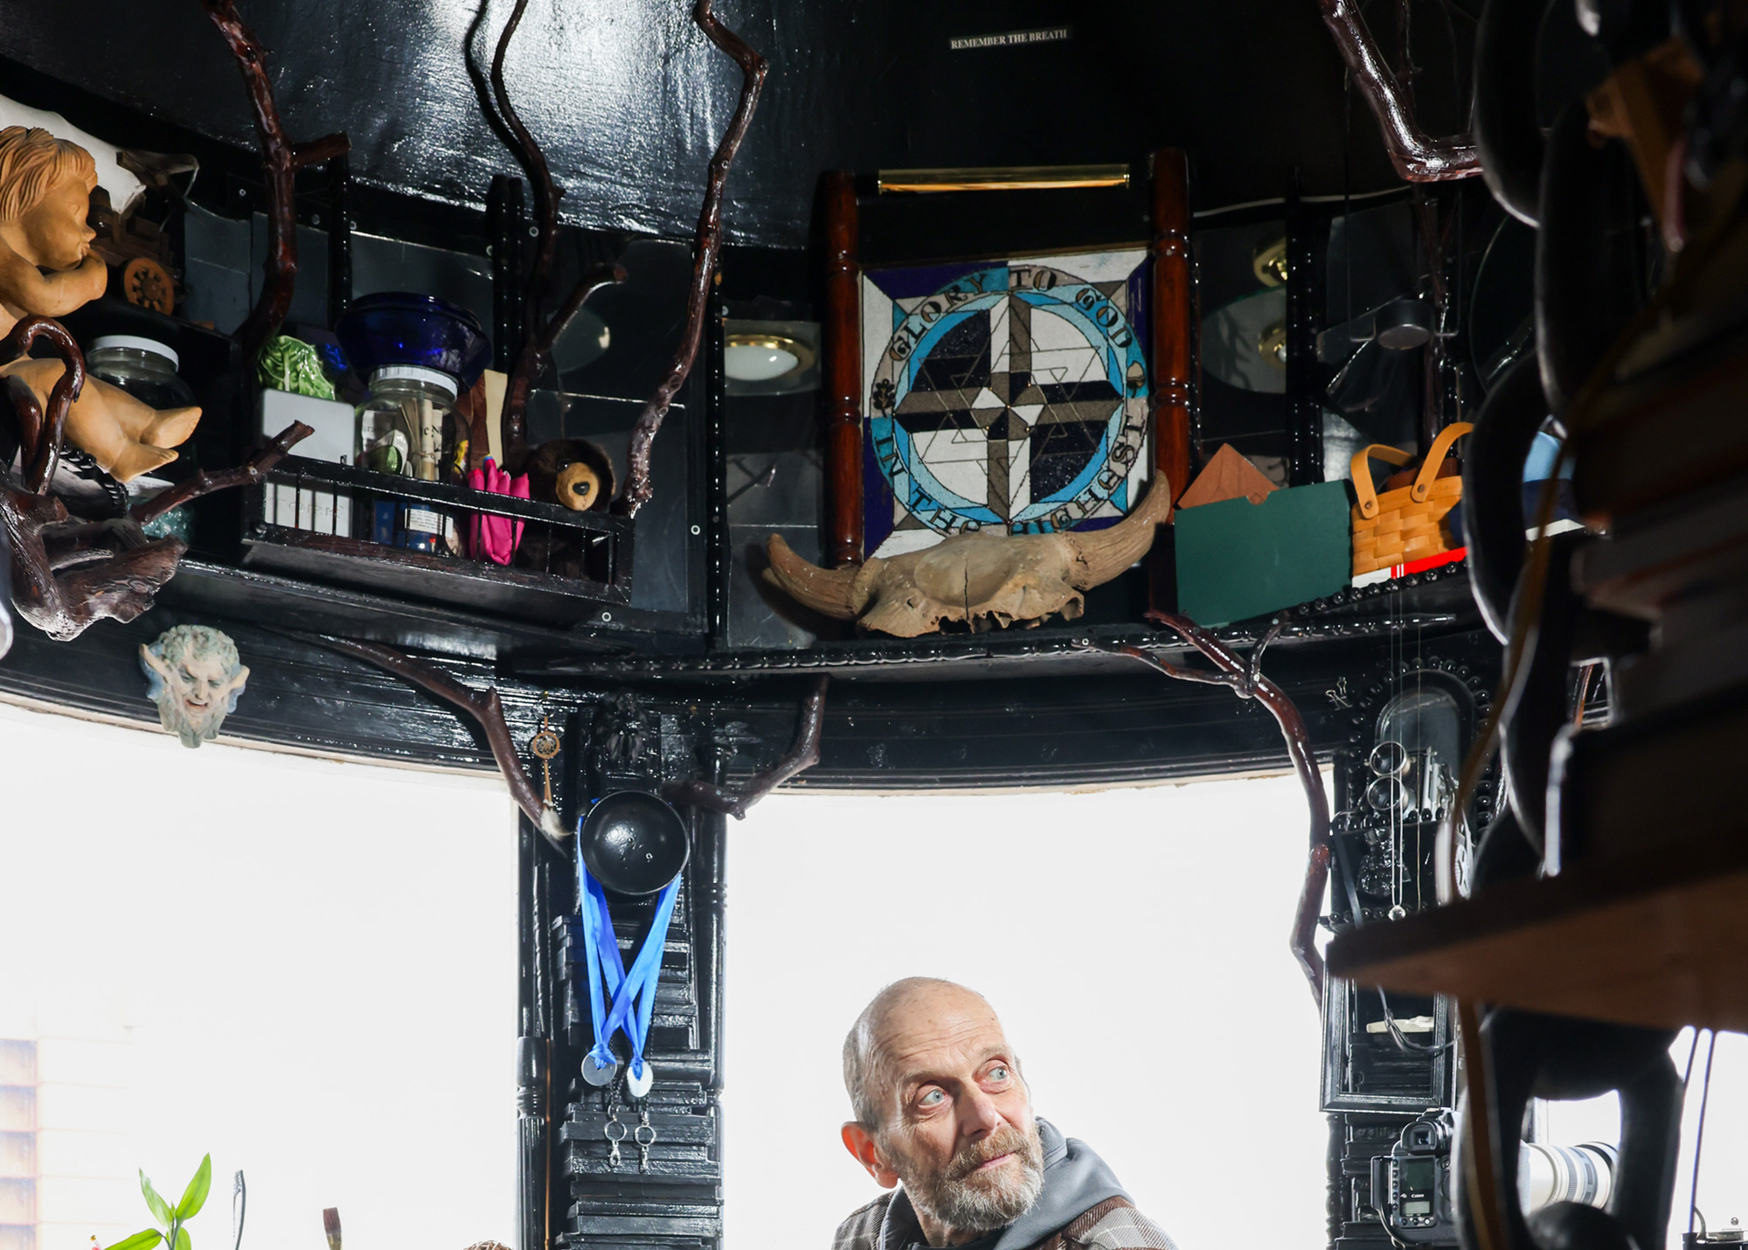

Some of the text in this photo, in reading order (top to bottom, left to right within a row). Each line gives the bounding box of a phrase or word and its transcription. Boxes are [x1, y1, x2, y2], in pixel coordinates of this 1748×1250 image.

[951, 29, 1067, 49] REMEMBER THE BREATH
[890, 268, 1133, 362] GLORY TO GOD
[874, 436, 906, 481] IN
[1007, 414, 1146, 536] HIGHEST
